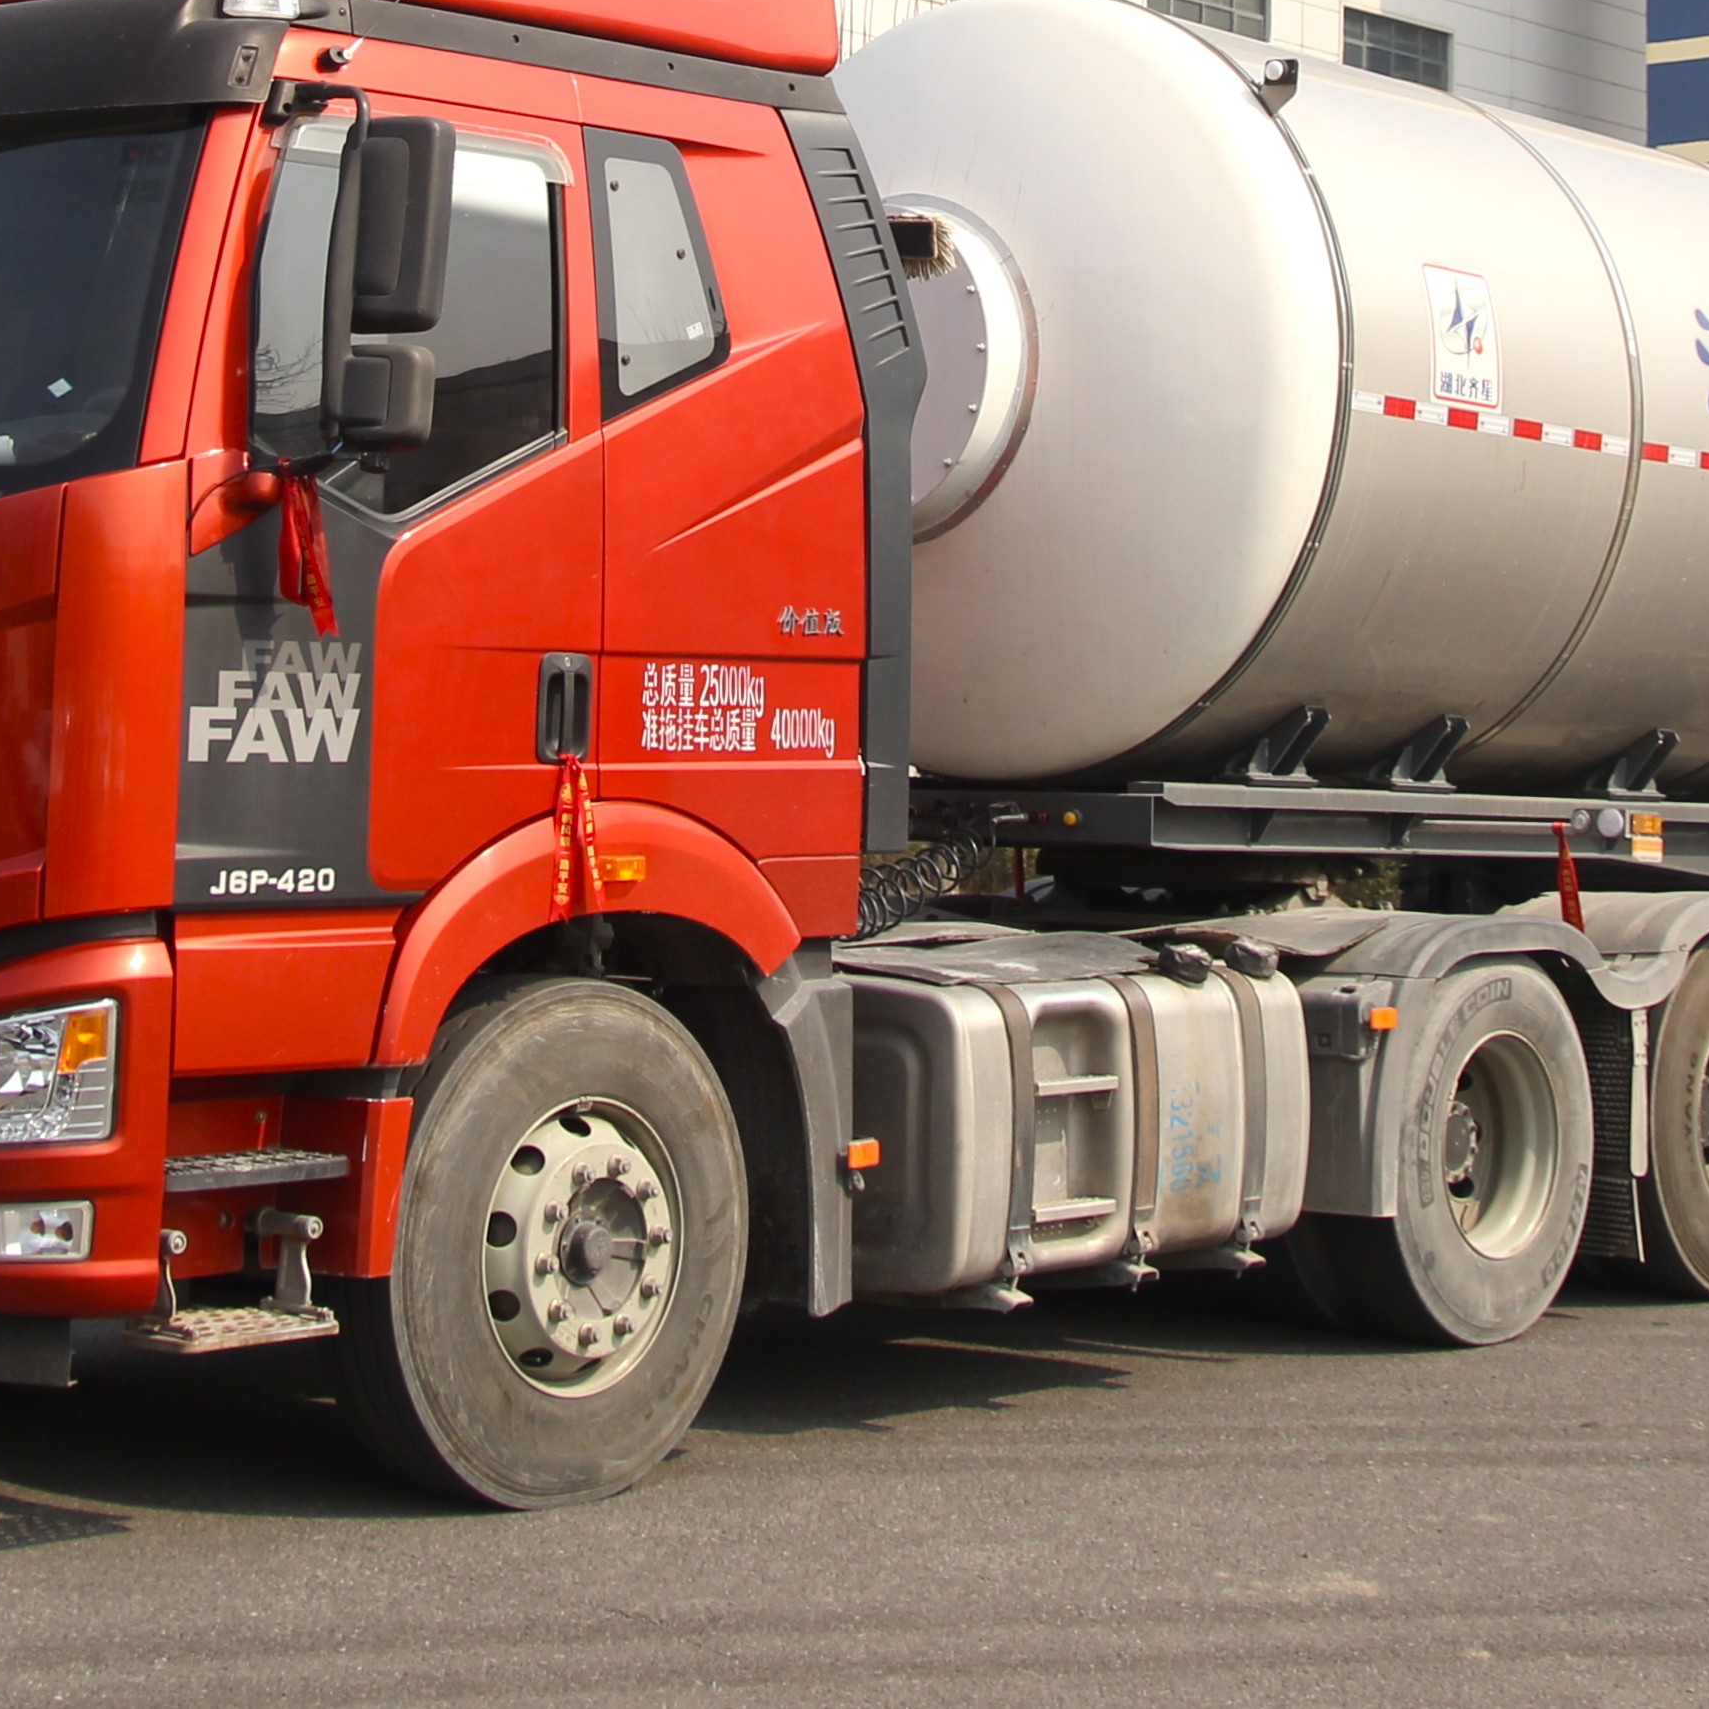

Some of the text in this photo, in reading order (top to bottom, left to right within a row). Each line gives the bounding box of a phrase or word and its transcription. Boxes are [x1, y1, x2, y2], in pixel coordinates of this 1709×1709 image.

[1439, 370, 1493, 402] 湖北齐星
[776, 604, 845, 636] 价值版
[242, 640, 363, 681] FAW
[217, 670, 363, 718] FAW
[642, 662, 765, 719] 总质量 25000kg
[188, 706, 362, 763] FAW
[641, 708, 835, 759] 准拖挂车总质量 40000kg
[209, 867, 336, 895] J6P-420
